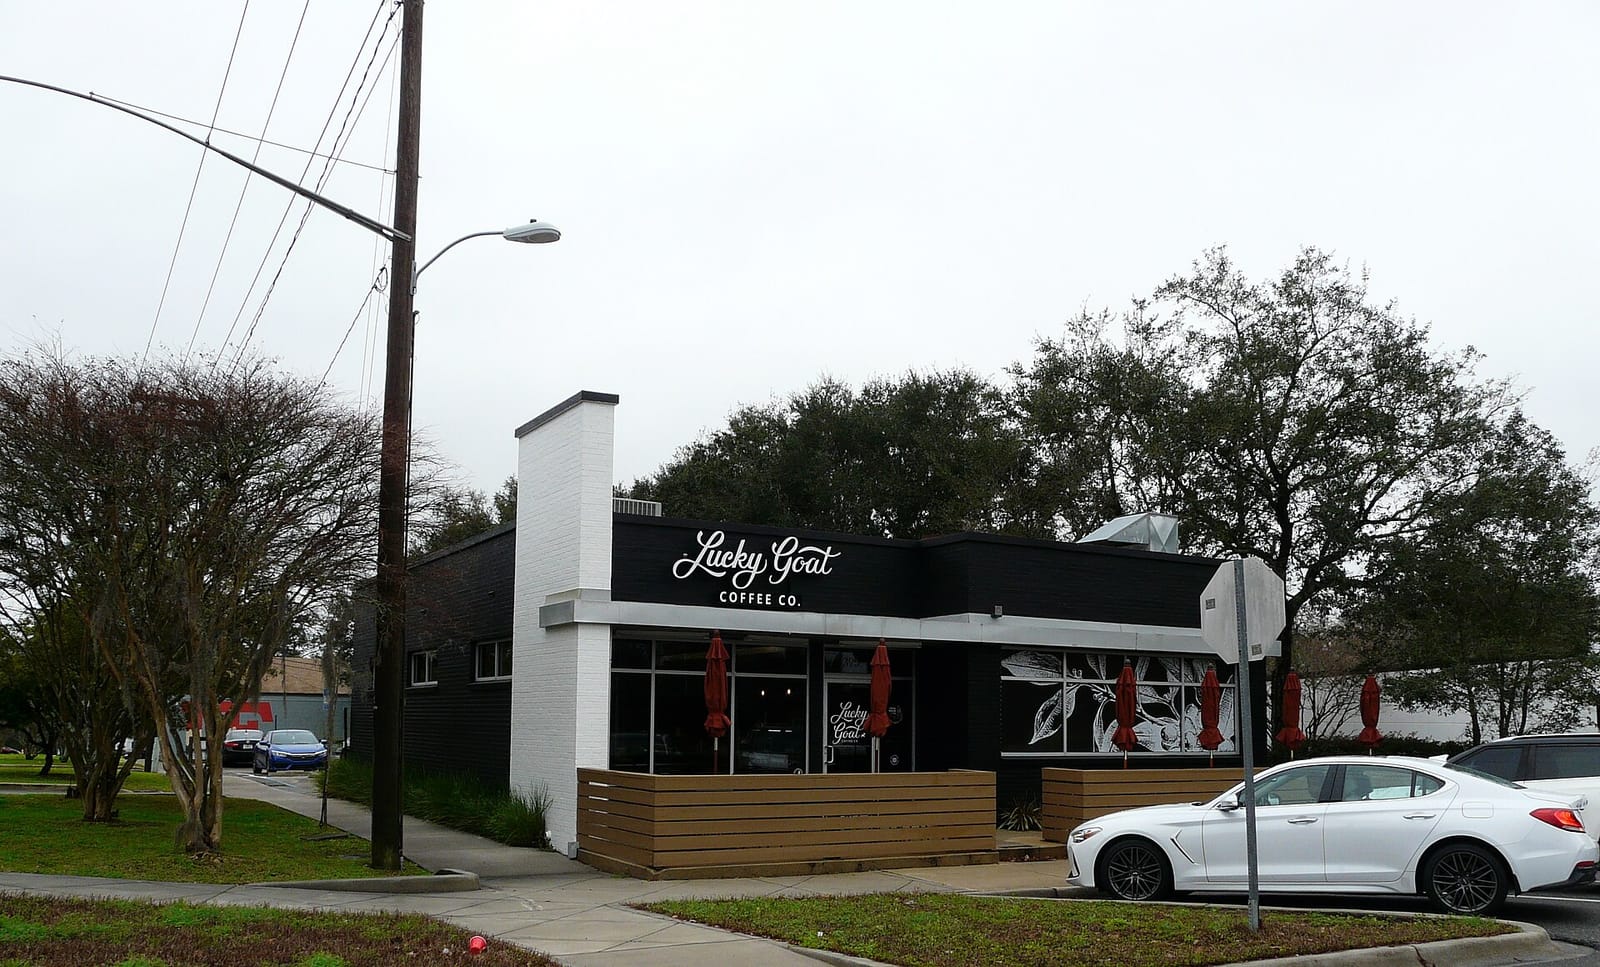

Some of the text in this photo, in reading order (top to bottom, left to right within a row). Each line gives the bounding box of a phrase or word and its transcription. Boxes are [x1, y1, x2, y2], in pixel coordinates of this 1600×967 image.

[672, 530, 841, 589] Lucky Goat
[719, 591, 801, 606] COFFEE CO.
[830, 701, 869, 727] Lucky
[832, 722, 864, 745] Goat
